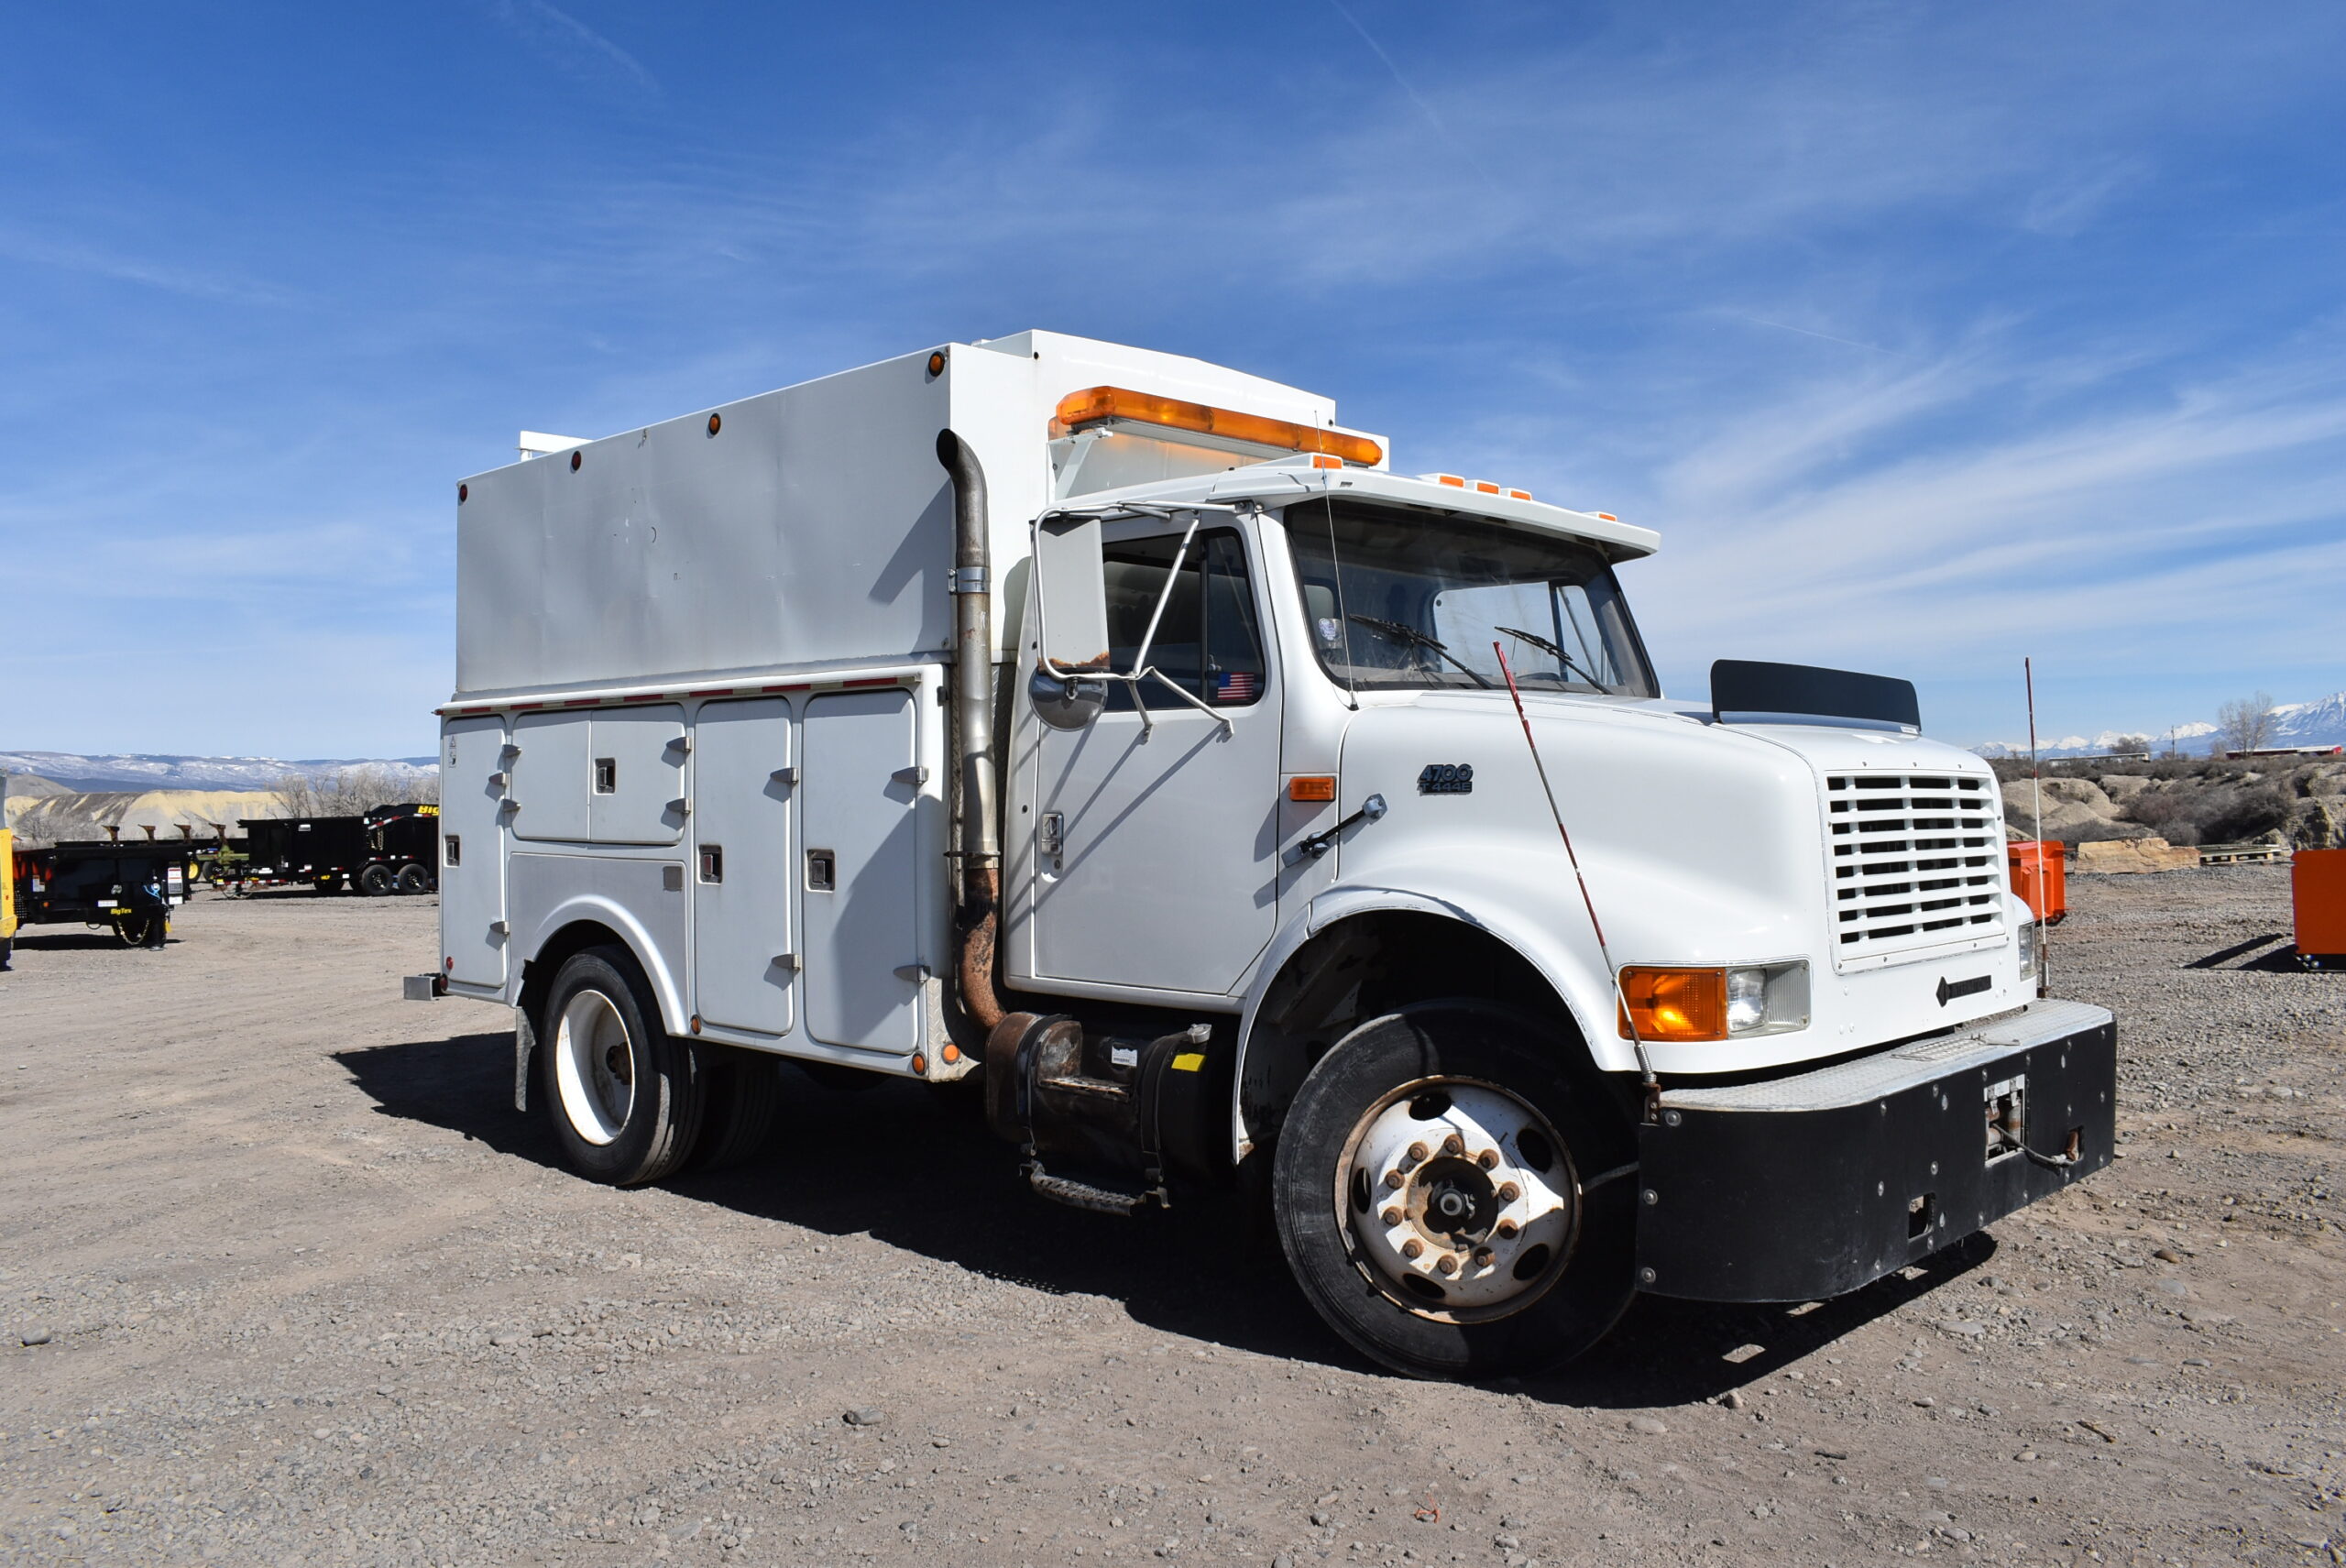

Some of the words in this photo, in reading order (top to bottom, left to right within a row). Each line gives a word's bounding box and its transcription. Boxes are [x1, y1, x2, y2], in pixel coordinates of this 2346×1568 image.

[1420, 763, 1473, 781] 4700
[1422, 783, 1430, 792] T
[1432, 783, 1471, 792] 444E
